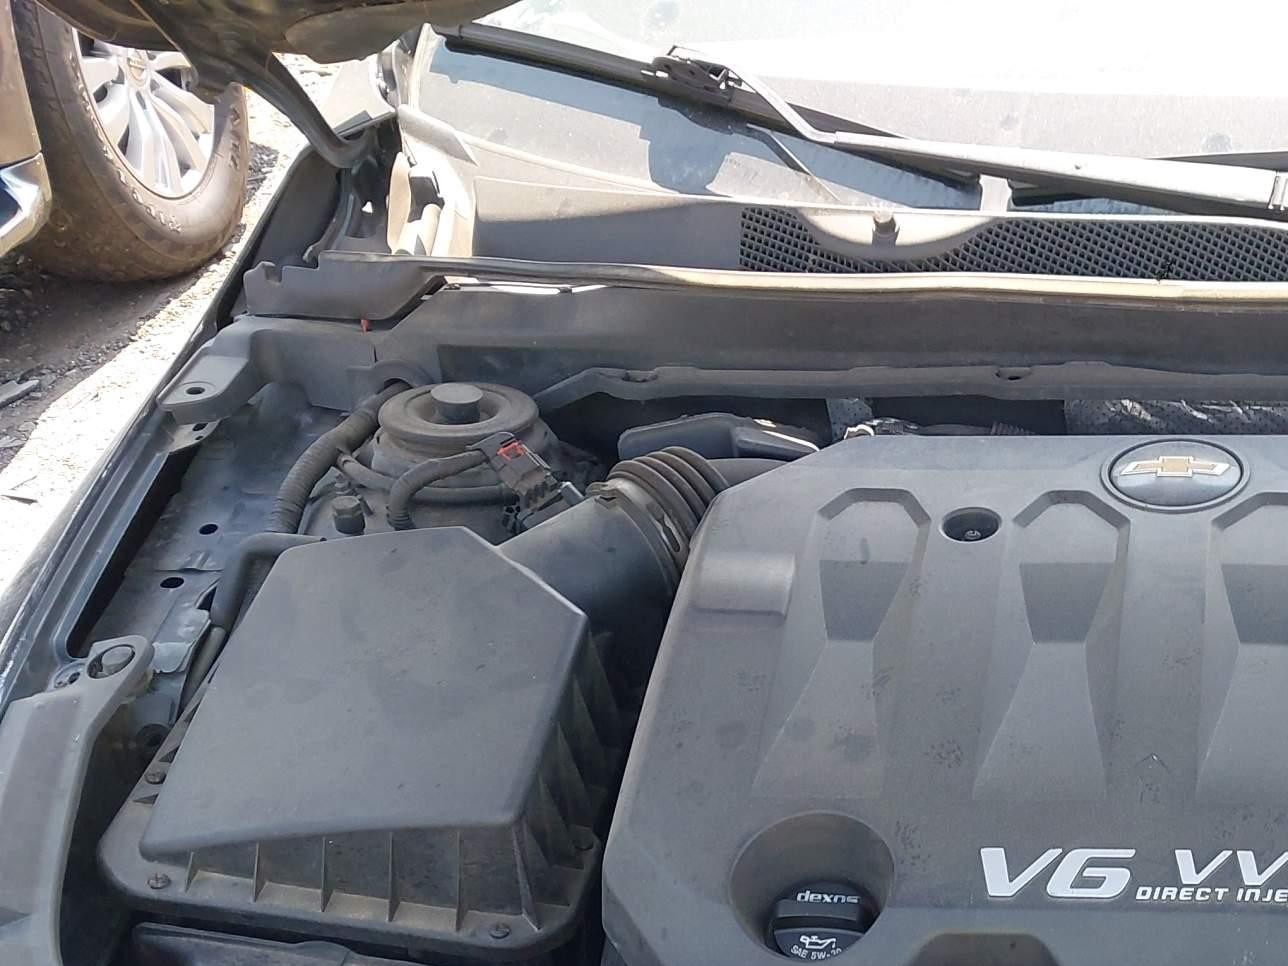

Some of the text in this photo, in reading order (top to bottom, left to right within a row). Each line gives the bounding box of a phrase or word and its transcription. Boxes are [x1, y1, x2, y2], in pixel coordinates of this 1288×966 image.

[980, 847, 1137, 900] V6
[1135, 887, 1229, 903] DIRECT
[790, 945, 809, 959] SAE
